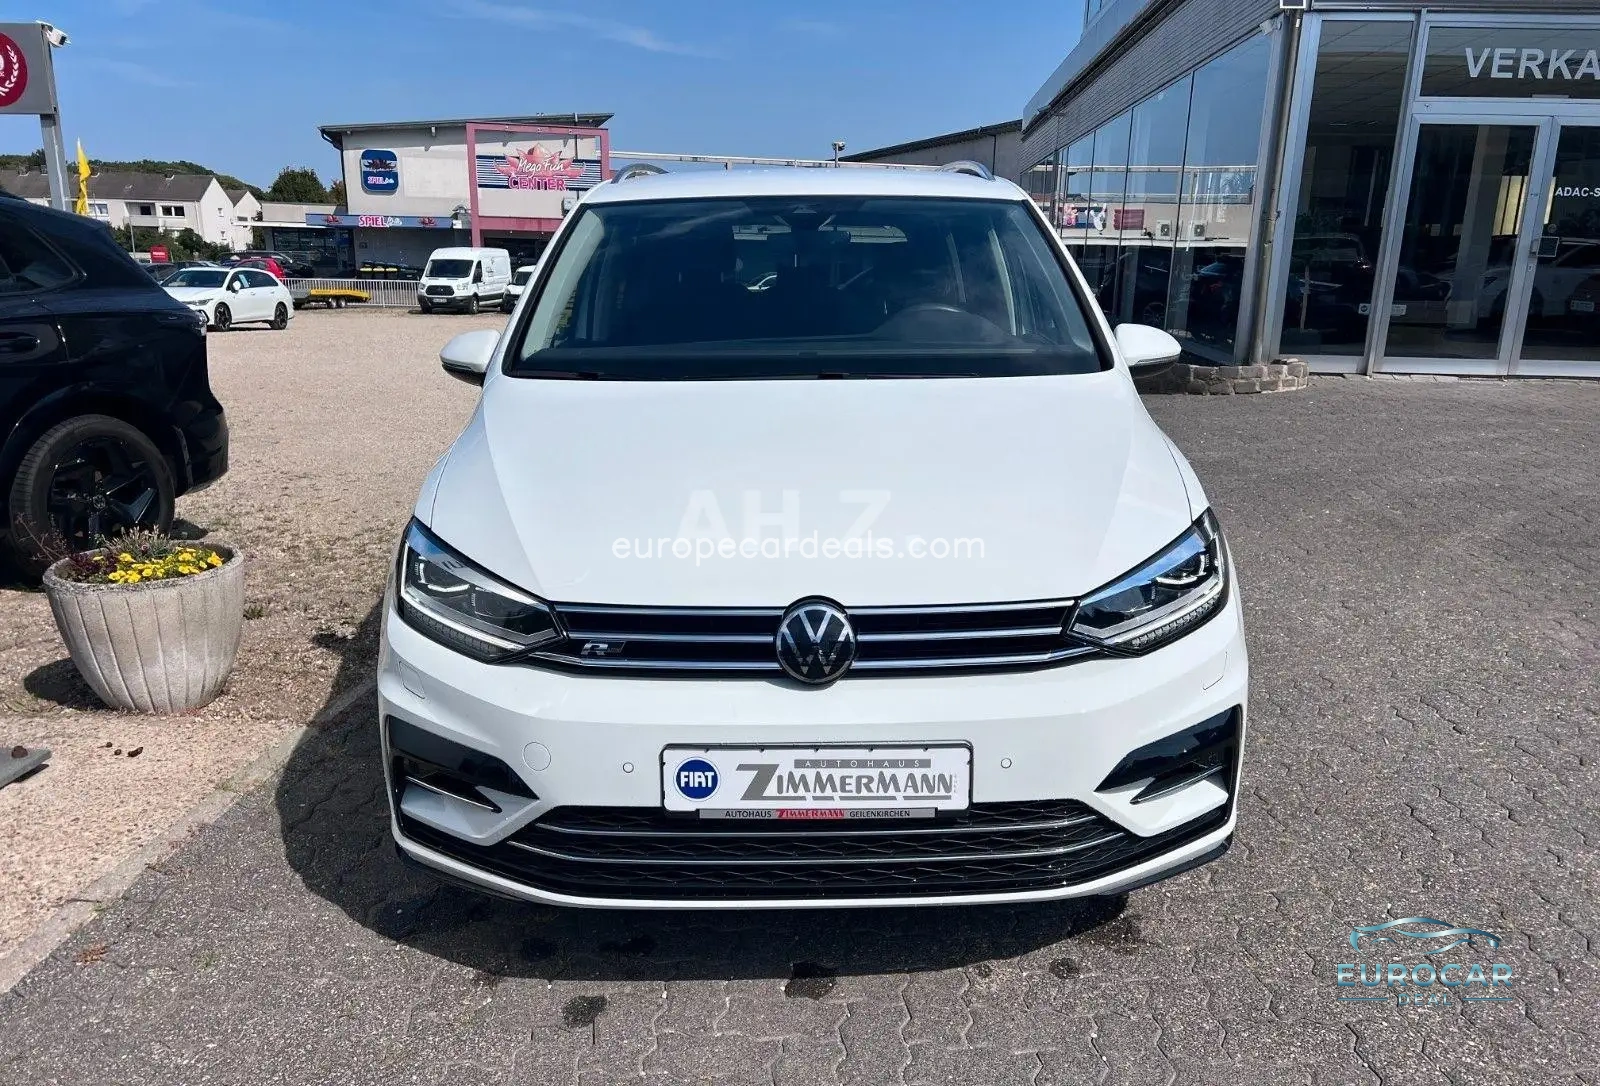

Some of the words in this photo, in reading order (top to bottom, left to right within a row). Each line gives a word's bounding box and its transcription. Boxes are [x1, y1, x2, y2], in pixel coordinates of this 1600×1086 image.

[1465, 47, 1600, 80] VERKA
[543, 157, 564, 171] Fun
[508, 176, 566, 191] CENTER
[1555, 187, 1600, 197] ADAC-S
[359, 215, 386, 228] SPIEL
[680, 771, 714, 788] FIAT
[736, 764, 952, 800] ZIMMERMANN
[777, 809, 844, 818] ZIMMERMANN
[849, 810, 911, 818] GEILENKIRCHEN
